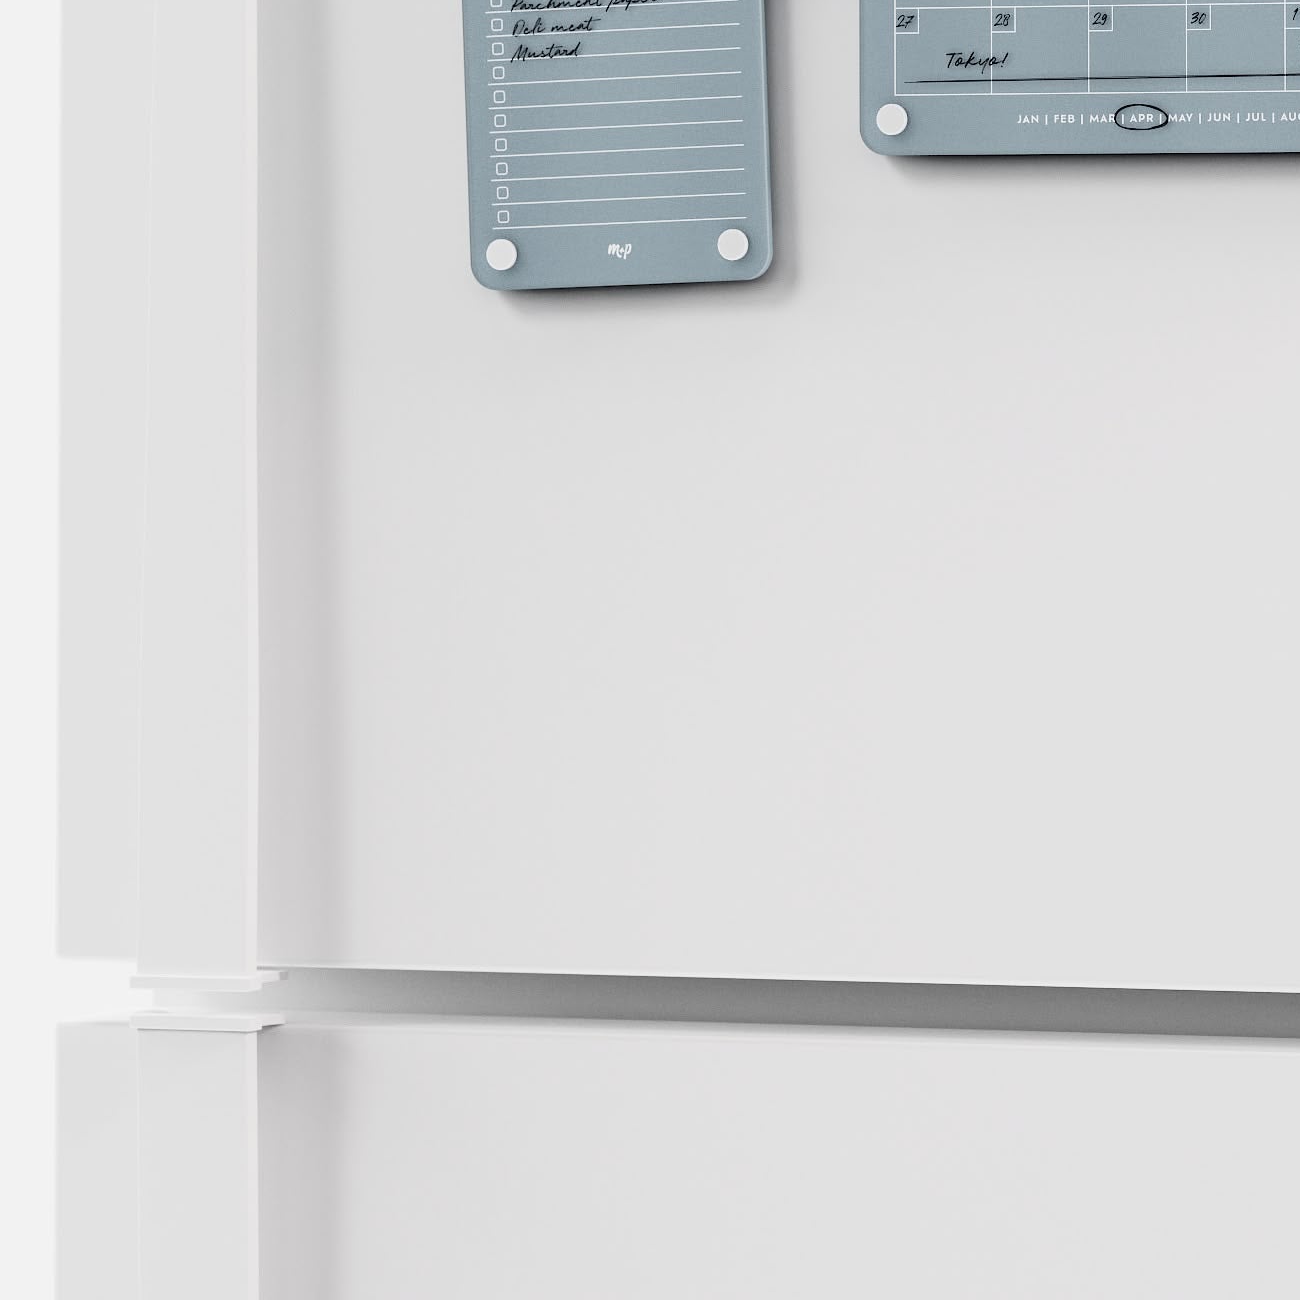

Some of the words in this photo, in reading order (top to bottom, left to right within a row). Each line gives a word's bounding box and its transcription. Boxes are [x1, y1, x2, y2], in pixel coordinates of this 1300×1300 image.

[512, 21, 546, 37] Deli
[551, 18, 601, 33] meat
[896, 15, 914, 28] 27
[994, 14, 1010, 27] 28
[1093, 12, 1108, 25] 29
[1191, 12, 1207, 25] 30
[1292, 8, 1298, 21] 1
[511, 42, 582, 63] Mustard
[946, 52, 1009, 73] Tokyo!
[1017, 114, 1039, 124] JAN
[1054, 114, 1075, 123] FEB
[1089, 113, 1115, 123] MAR
[1129, 113, 1154, 122] APR
[1168, 113, 1193, 122] MAY
[1208, 112, 1231, 122] JUN
[1246, 112, 1266, 122] JUL
